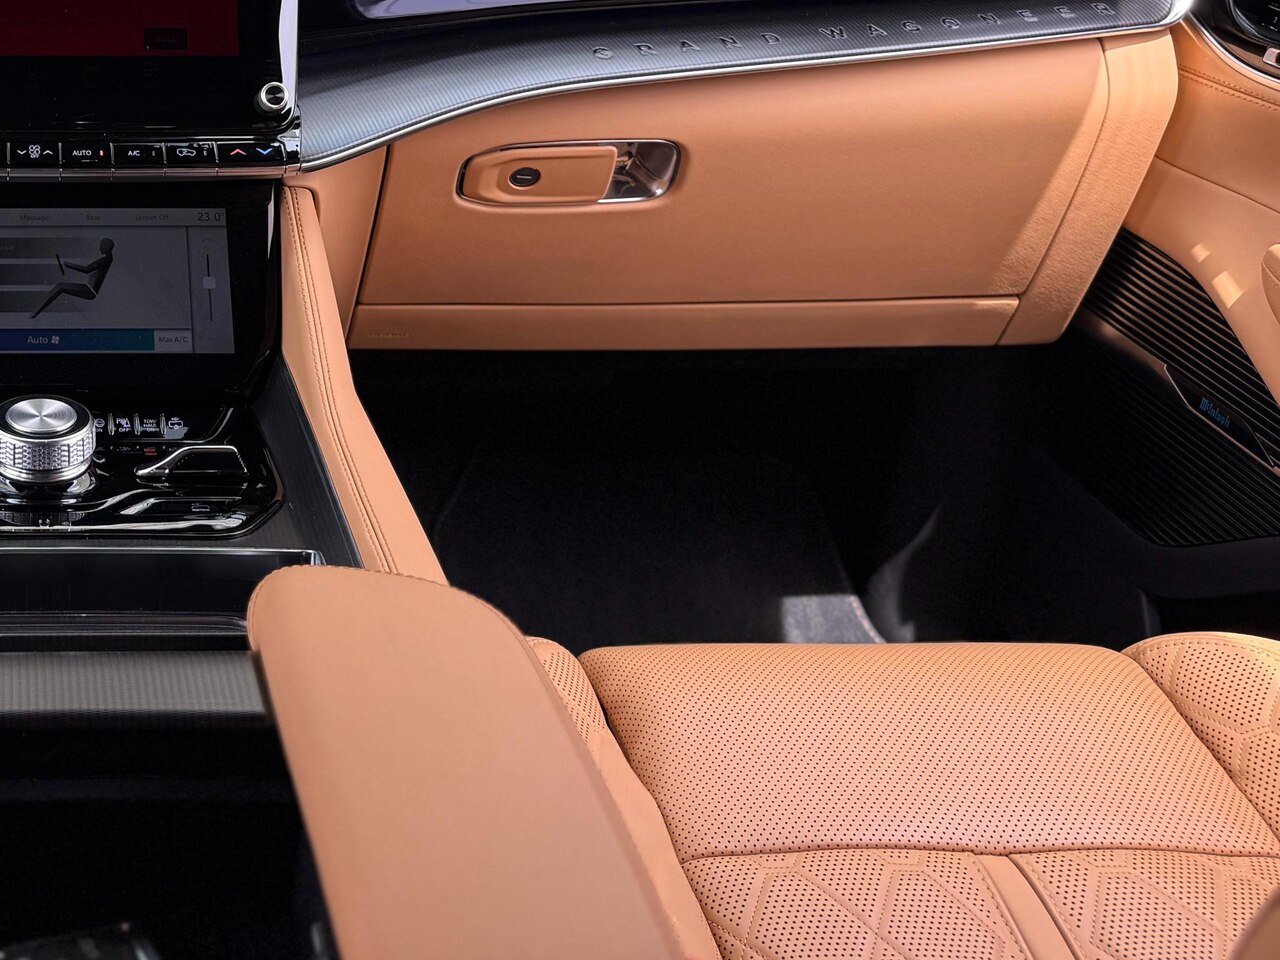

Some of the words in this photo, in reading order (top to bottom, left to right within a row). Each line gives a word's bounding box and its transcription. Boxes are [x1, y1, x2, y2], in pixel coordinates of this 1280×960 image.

[592, 31, 780, 60] GRAND
[820, 2, 1117, 40] WAGONEER
[27, 336, 49, 344] Auto
[173, 336, 189, 344] A/C
